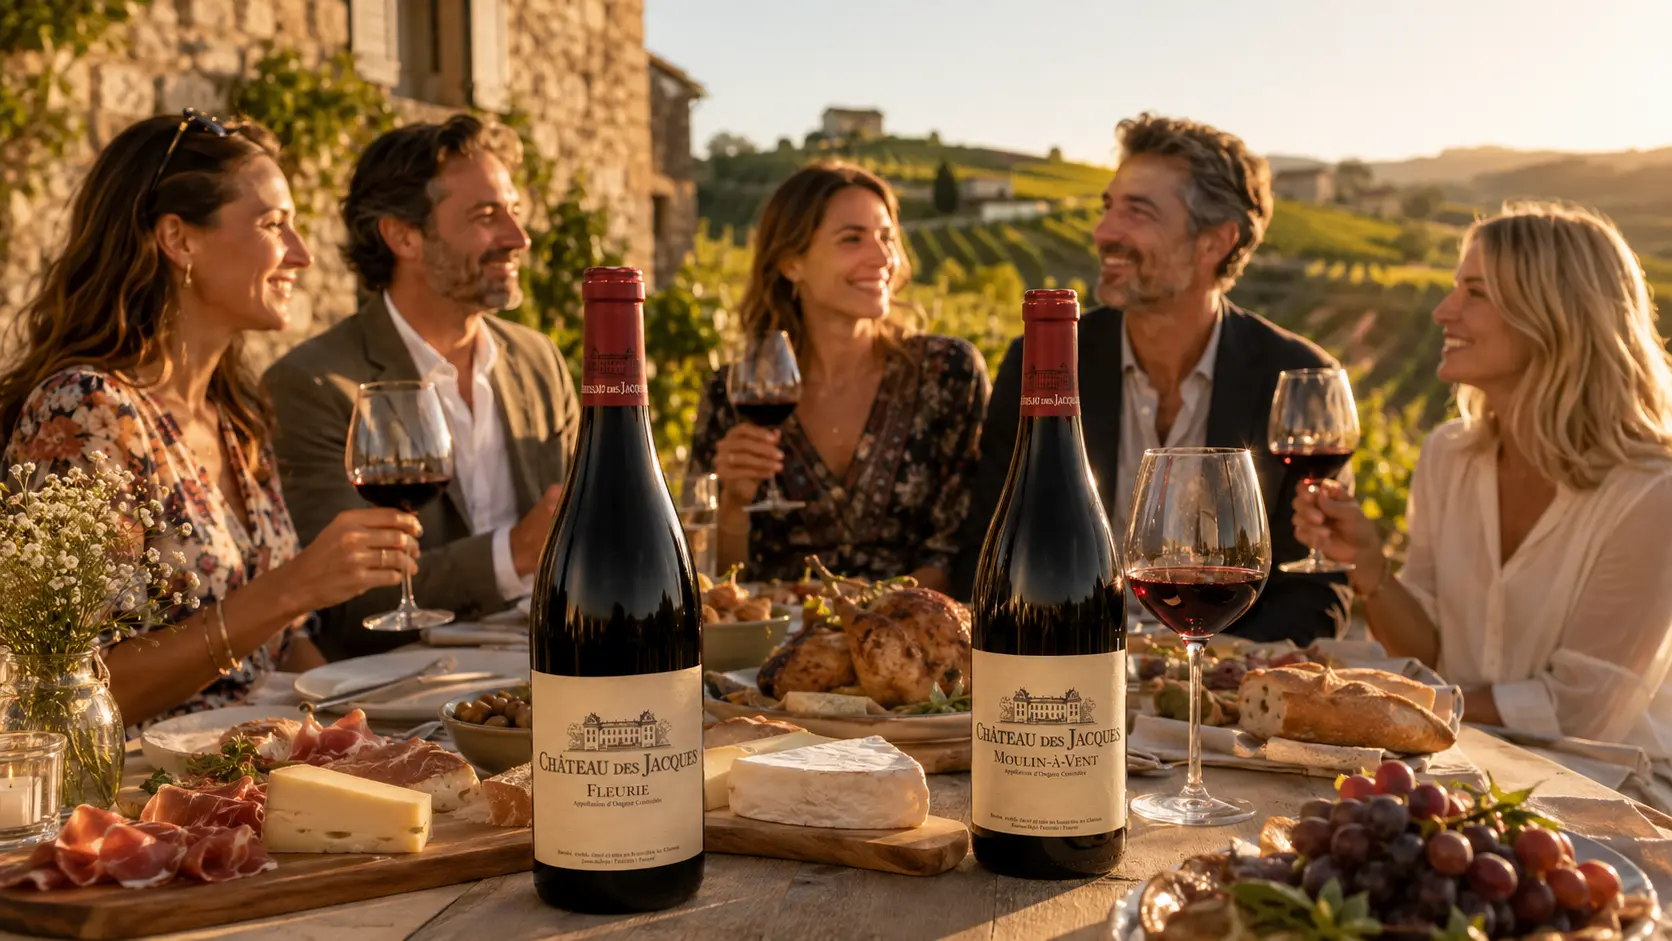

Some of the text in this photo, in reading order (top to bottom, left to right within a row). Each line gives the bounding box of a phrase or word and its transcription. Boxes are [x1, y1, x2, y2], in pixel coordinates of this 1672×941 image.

[976, 721, 1121, 750] CHÂTEAU DES JACQUES
[539, 749, 699, 778] CHÂTEAU DES JACQUES
[994, 749, 1099, 768] MOULIN-À-VENT
[586, 783, 650, 798] FLEURIE
